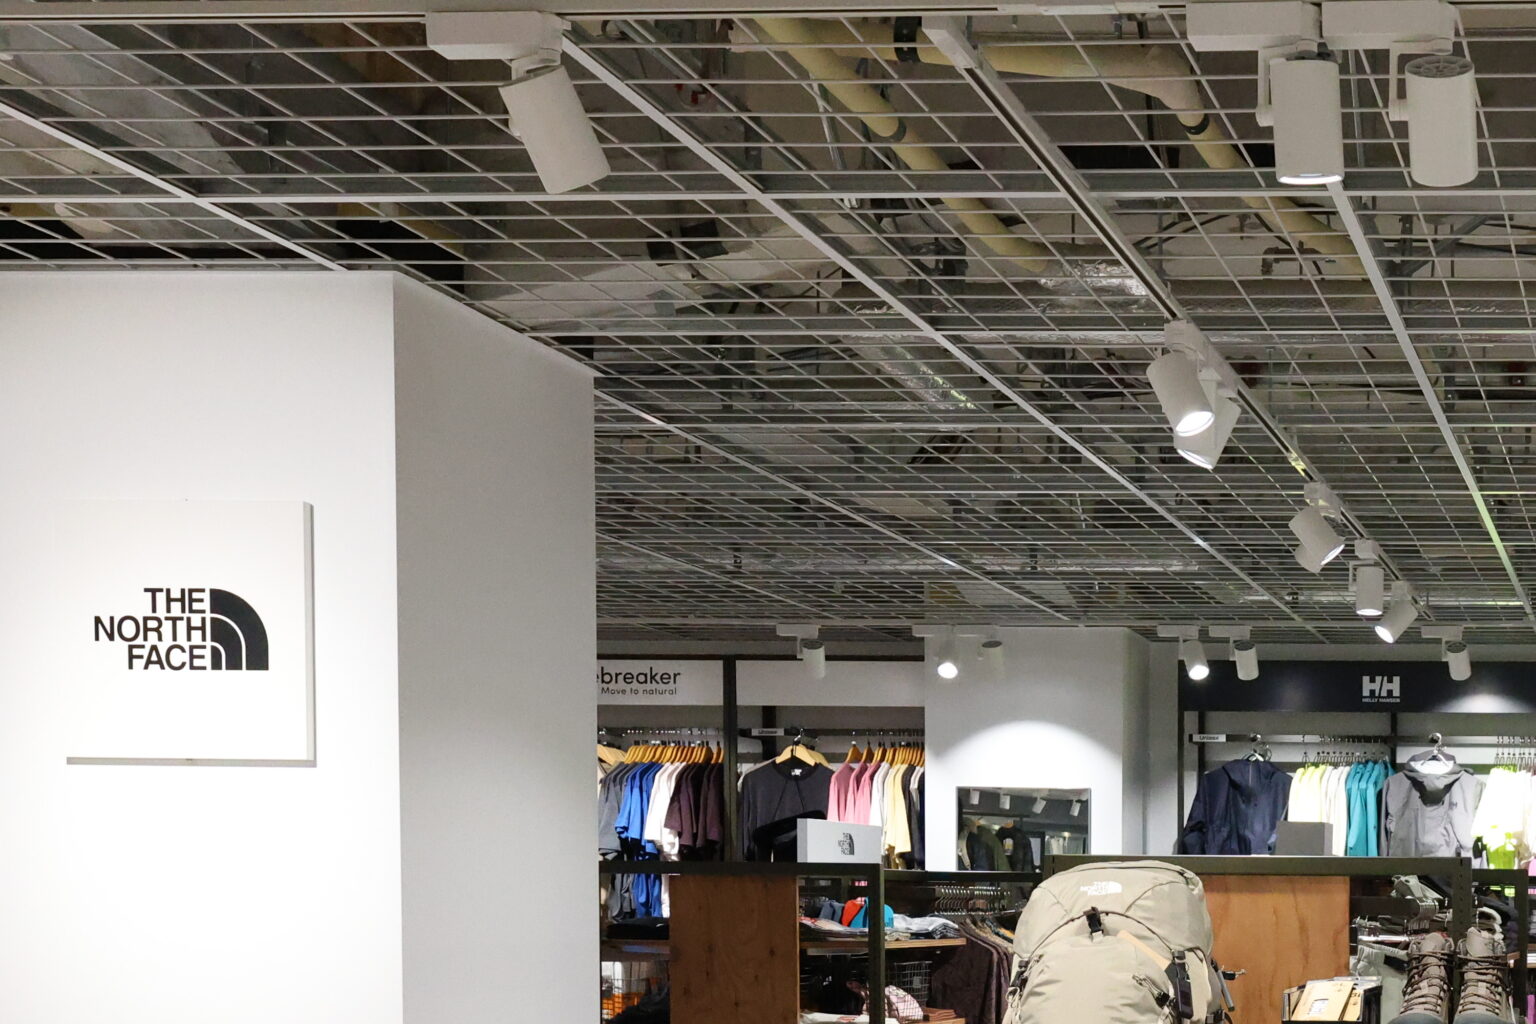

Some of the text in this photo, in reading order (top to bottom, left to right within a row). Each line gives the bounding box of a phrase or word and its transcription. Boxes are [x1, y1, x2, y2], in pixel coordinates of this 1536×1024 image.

[144, 588, 206, 614] THE
[94, 615, 206, 642] NORTH
[128, 644, 207, 670] FACE
[597, 666, 682, 684] breaker
[601, 687, 677, 695] Move to natural
